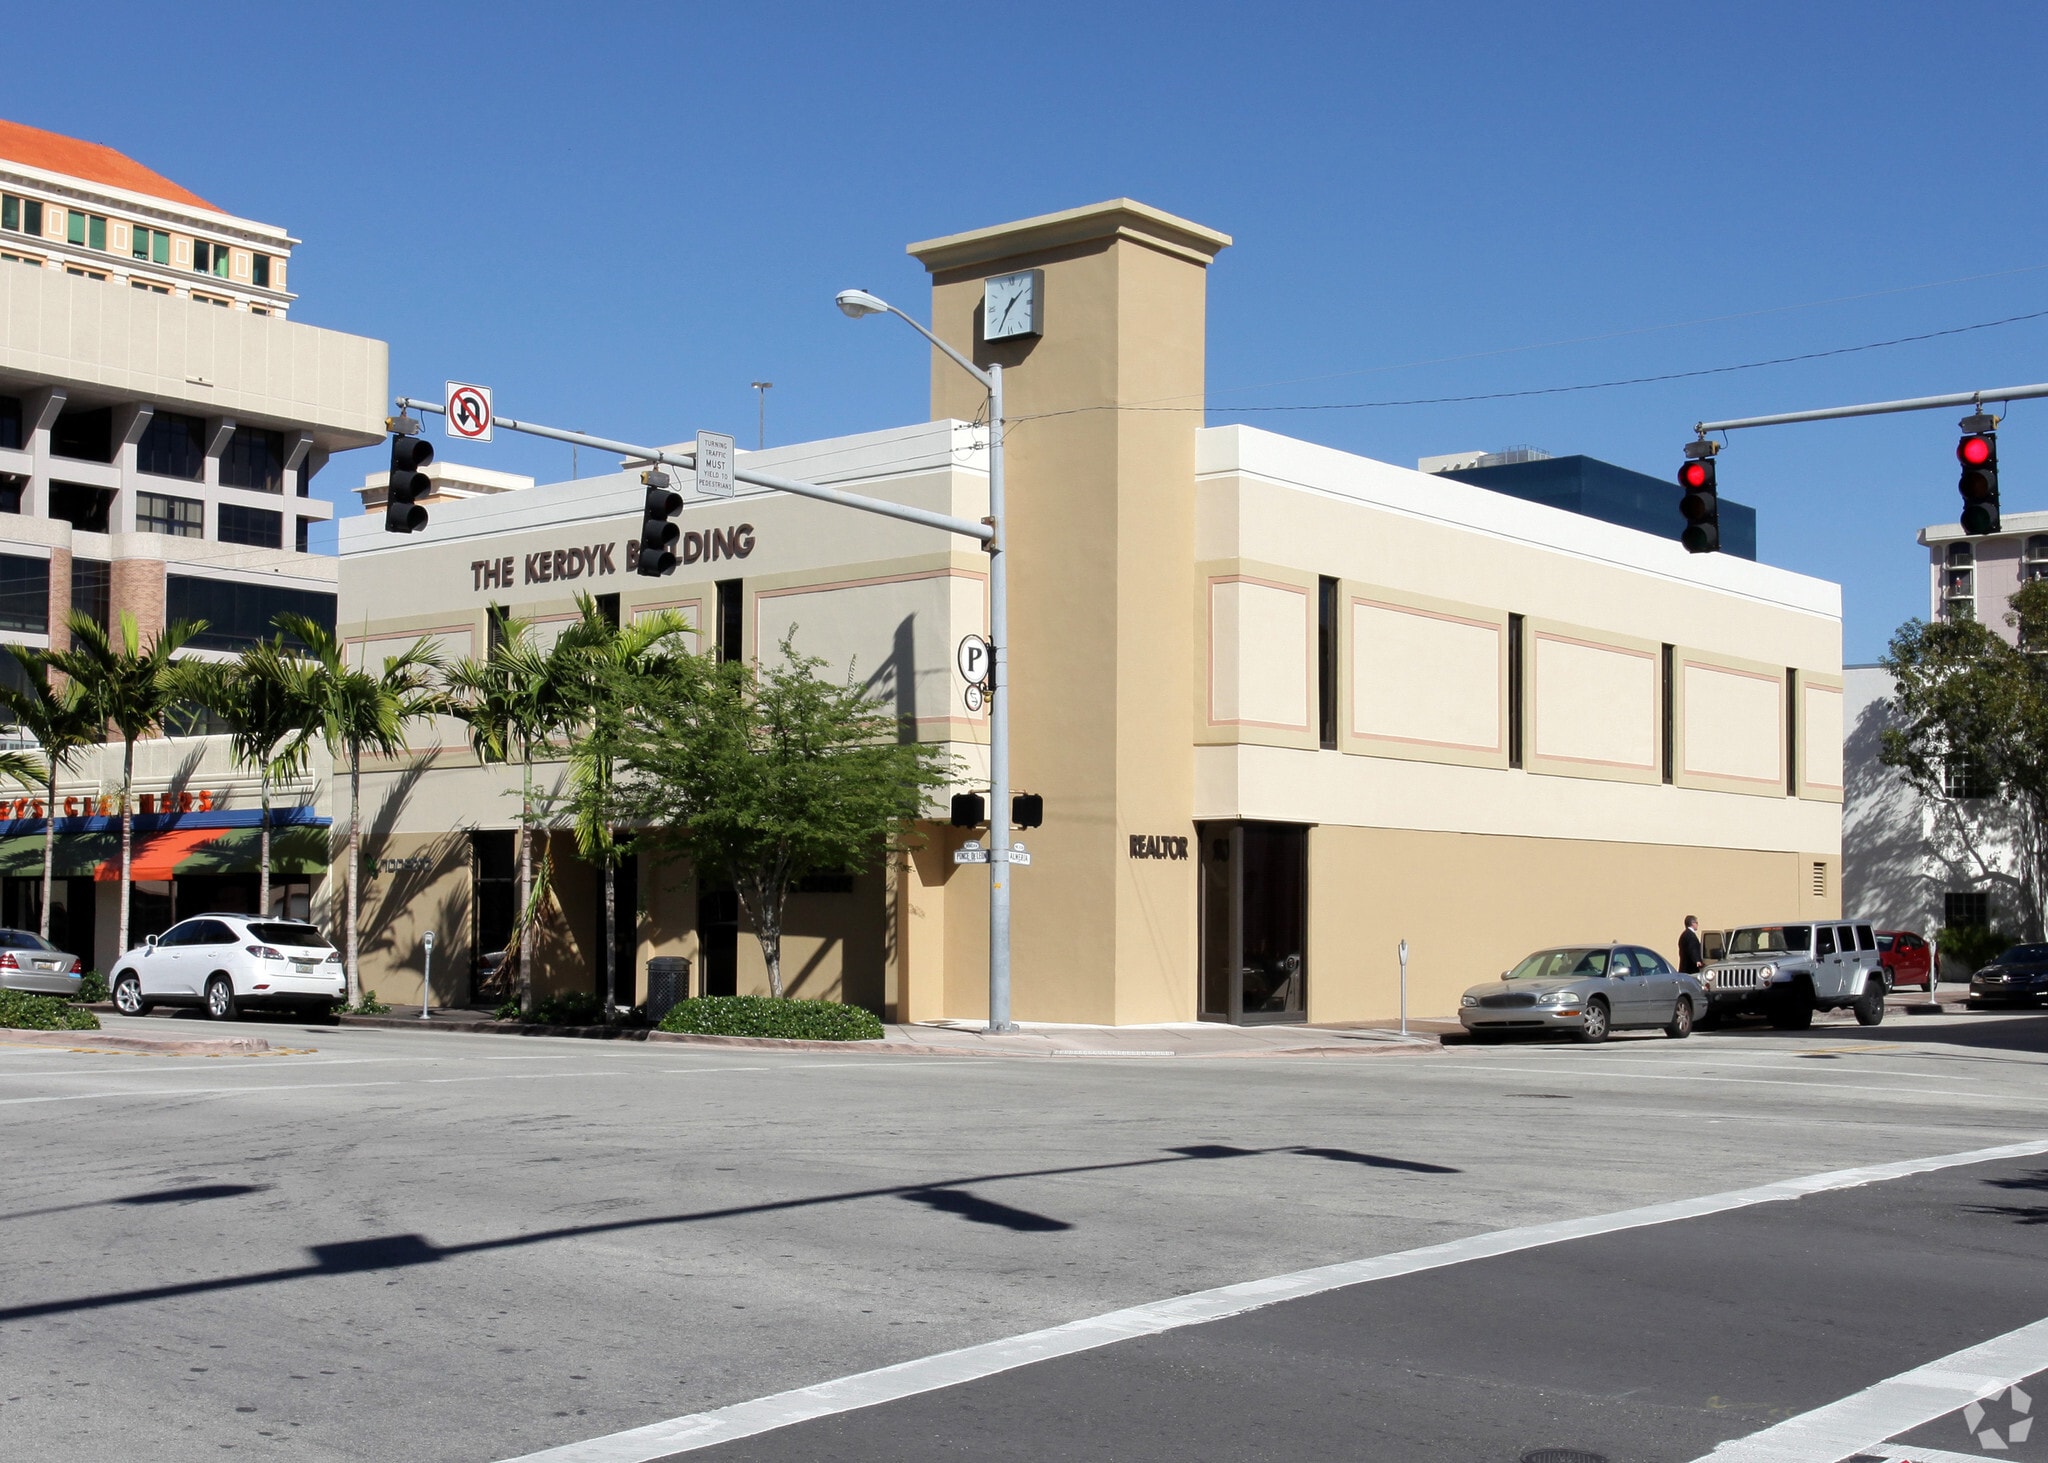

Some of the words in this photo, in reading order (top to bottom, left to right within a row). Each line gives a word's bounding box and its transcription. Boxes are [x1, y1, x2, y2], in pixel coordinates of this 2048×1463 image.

[704, 439, 727, 450] TURNING
[705, 449, 727, 459] TRAFFIC
[705, 459, 726, 470] MUST
[704, 470, 719, 478] YIELD
[698, 478, 732, 490] PEDESTRIANS
[471, 556, 514, 591] THE
[525, 542, 616, 585] KERDYK
[626, 523, 756, 572] BDING
[967, 646, 982, 672] P
[64, 790, 213, 818] CLENERS
[1129, 834, 1189, 861] REALTOR
[1009, 853, 1028, 862] ALMERIA
